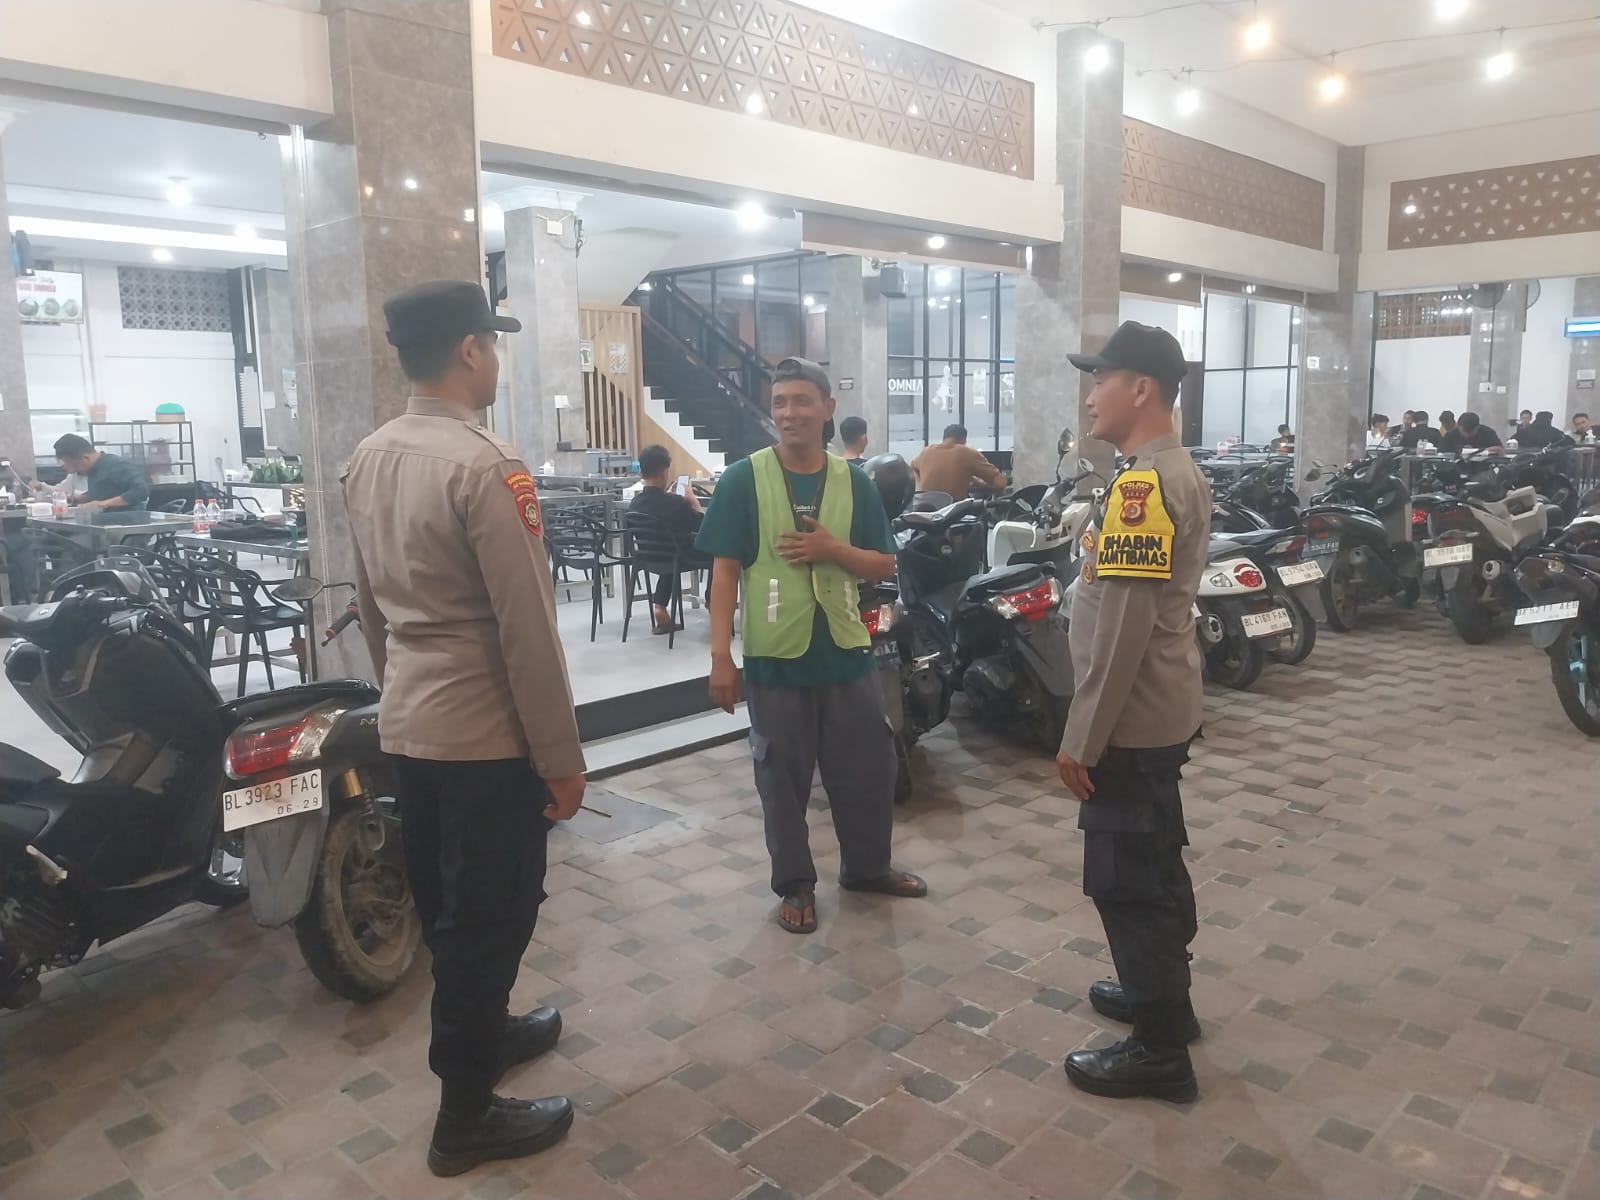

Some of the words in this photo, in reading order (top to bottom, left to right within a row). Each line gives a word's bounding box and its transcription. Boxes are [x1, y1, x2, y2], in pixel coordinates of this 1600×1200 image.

[225, 792, 242, 810] BL
[245, 782, 282, 806] 3923
[290, 773, 319, 795] FAC
